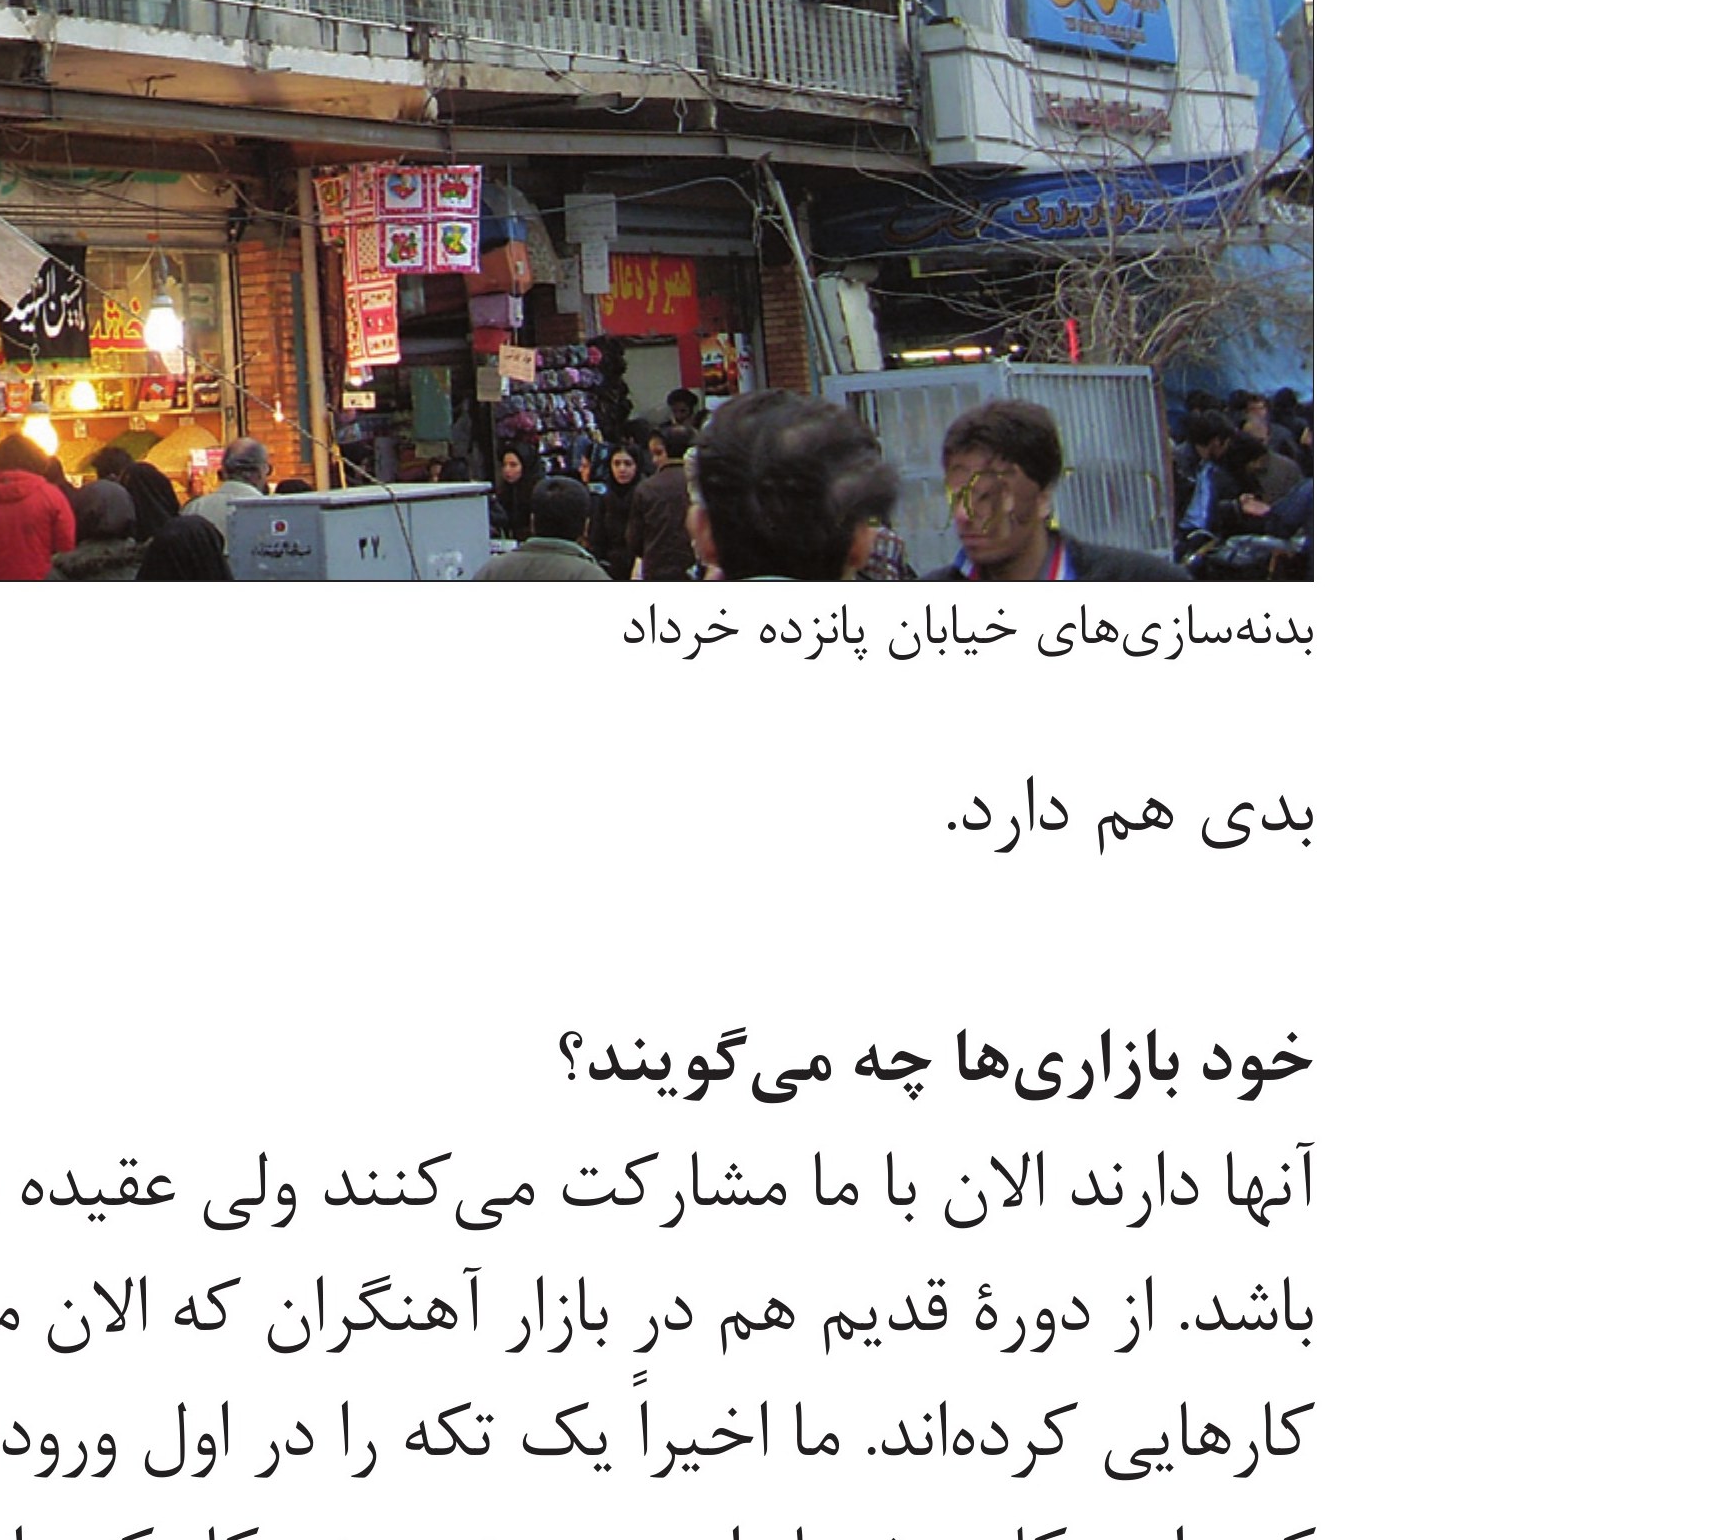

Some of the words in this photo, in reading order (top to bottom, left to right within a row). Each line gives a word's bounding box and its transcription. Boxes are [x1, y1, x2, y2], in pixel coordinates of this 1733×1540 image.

[1012, 195, 1083, 232] بزرگ
[624, 604, 739, 660] خرداد
[760, 604, 867, 660] پانزده
[889, 604, 1017, 660] خیابان
[948, 776, 1068, 853] دارد.
[1098, 798, 1173, 855] هم
[1202, 795, 1313, 849] بدی
[855, 1044, 932, 1100] چه
[1203, 1032, 1312, 1101] خود
[22, 1158, 175, 1222] عقیده
[204, 1152, 296, 1230] ولی
[563, 1152, 786, 1228] مشارکت
[815, 1152, 858, 1205] ما
[887, 1152, 916, 1222] با
[945, 1151, 1043, 1228] الان
[1072, 1151, 1198, 1228] دارند
[1227, 1142, 1315, 1227] آنها
[48, 1276, 146, 1353] الان
[175, 1277, 241, 1330] که
[268, 1267, 481, 1353] آهنگران
[505, 1276, 608, 1353] بازار
[633, 1296, 692, 1353] در
[721, 1298, 794, 1355] هم
[824, 1278, 947, 1355] قدیم
[1114, 1276, 1152, 1353] از
[1181, 1277, 1313, 1347] باشد.
[145, 1401, 228, 1478] اول
[254, 1421, 313, 1478] در
[342, 1401, 376, 1478] را
[406, 1402, 494, 1455] تکه
[523, 1402, 612, 1472] یک
[796, 1402, 839, 1455] ما
[1105, 1402, 1315, 1480] کارهایی
